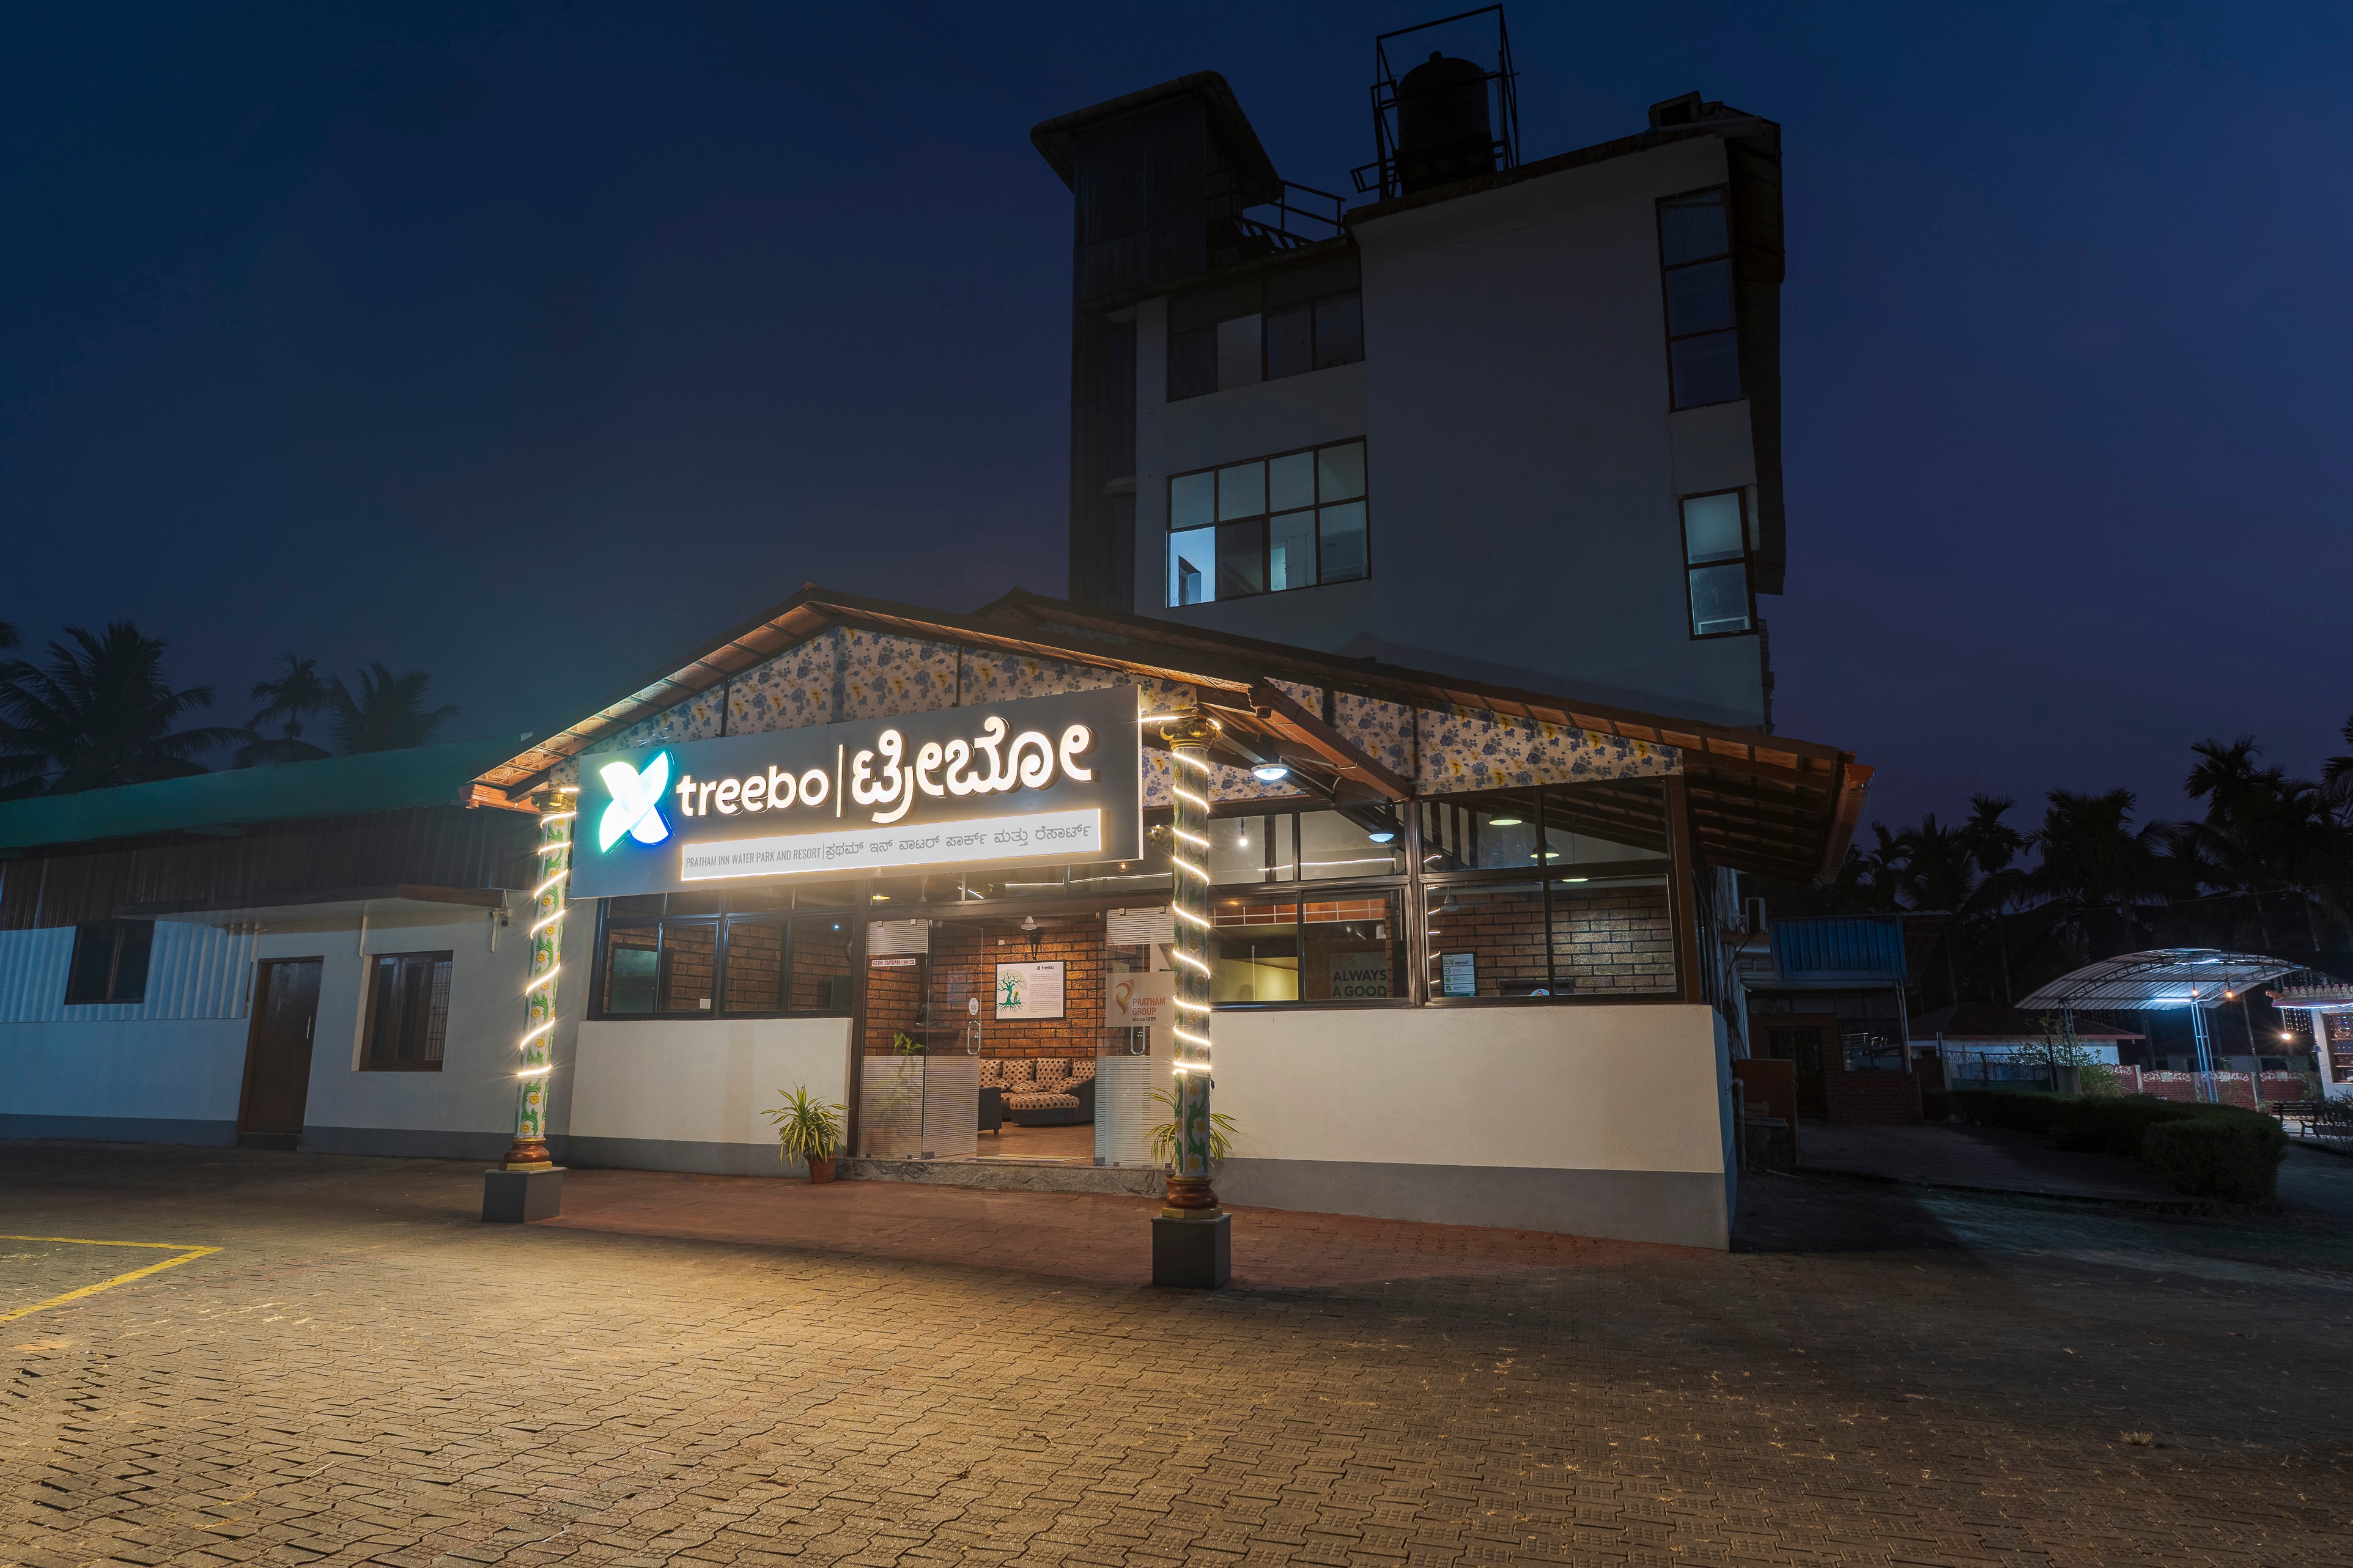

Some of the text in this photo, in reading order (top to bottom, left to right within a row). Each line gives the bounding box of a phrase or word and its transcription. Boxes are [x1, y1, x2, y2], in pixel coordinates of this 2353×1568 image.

[852, 716, 1093, 824] ಟ್ರೀಬೋ
[676, 765, 829, 817] treebo
[870, 839, 893, 853] ಇನ್
[899, 835, 940, 850] ವಾಟರ್
[946, 832, 987, 847] ಪಾರ್ಕ್
[994, 827, 1029, 846] ಮತ್ತು
[1035, 823, 1092, 840] ರೆಸಾರ್ಟ್
[685, 847, 821, 868] PRATHAM INN WATER PARK AND RESORT
[1333, 970, 1387, 982] ALWAYS
[1332, 985, 1387, 997] A GOOD
[1132, 997, 1165, 1006] PRATHAM
[1132, 1007, 1156, 1016] GROUP
